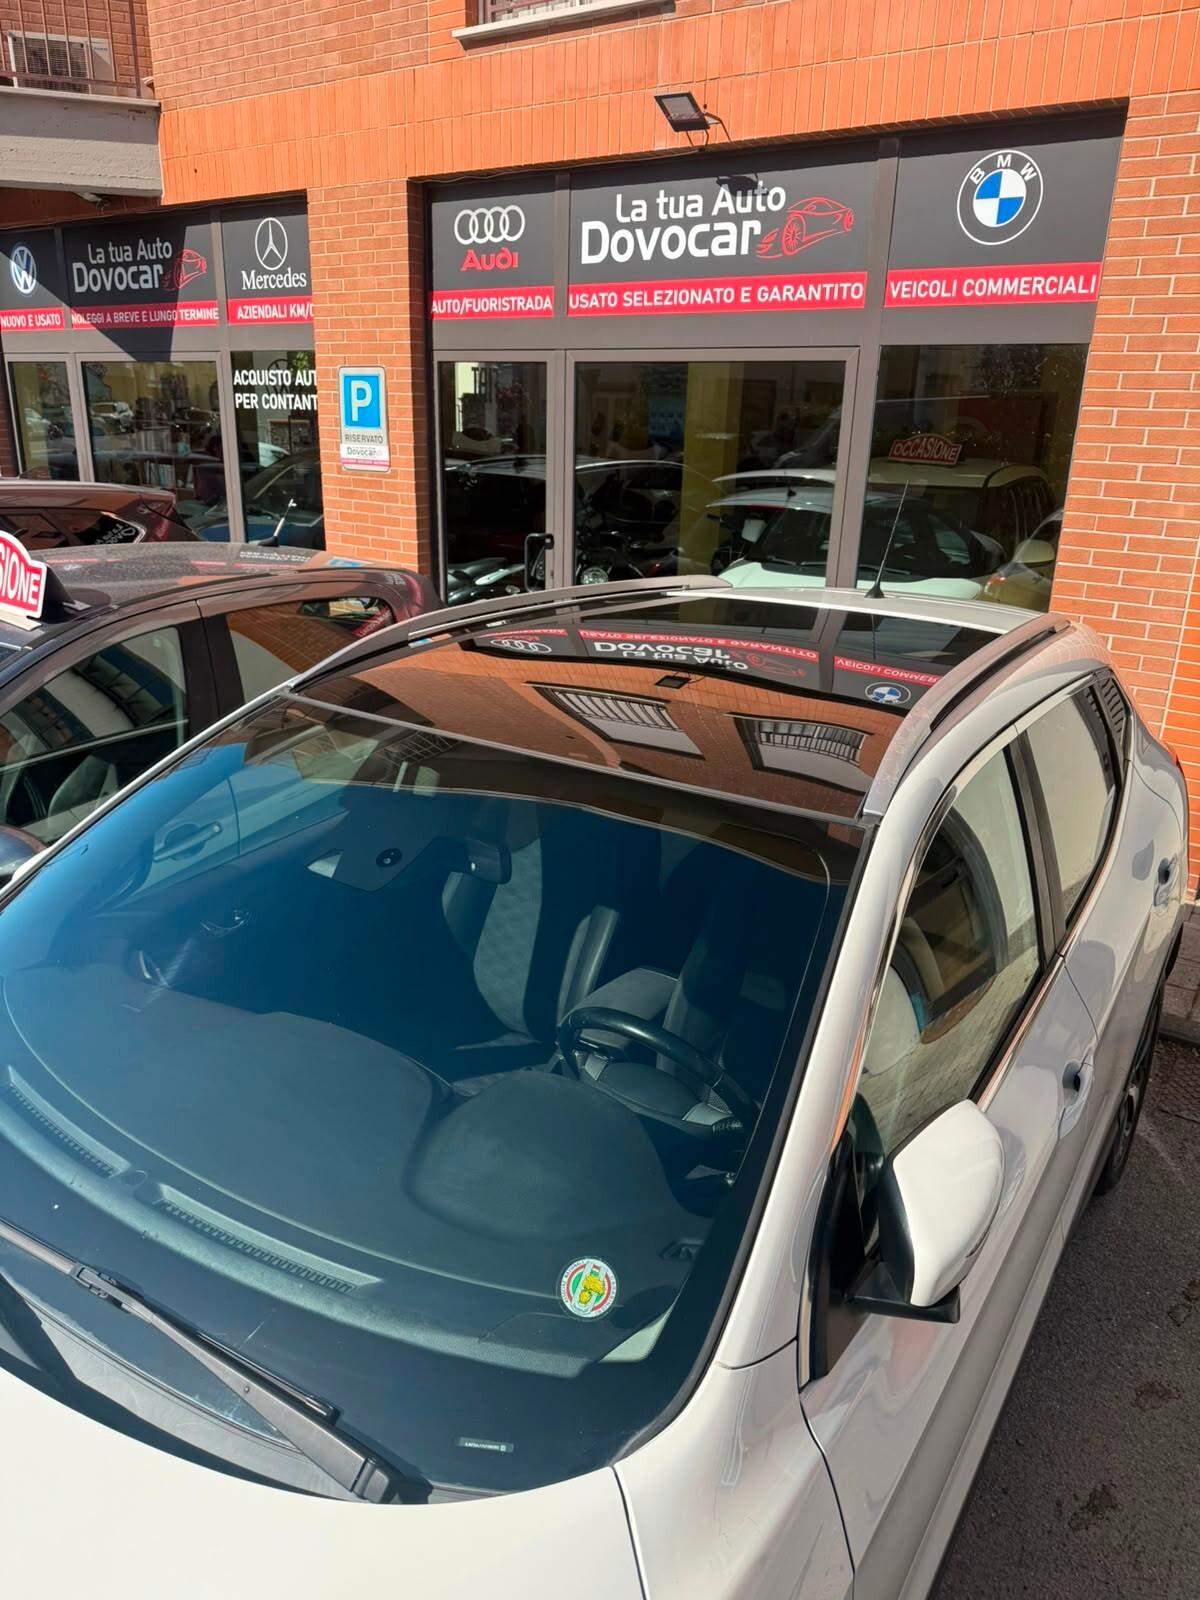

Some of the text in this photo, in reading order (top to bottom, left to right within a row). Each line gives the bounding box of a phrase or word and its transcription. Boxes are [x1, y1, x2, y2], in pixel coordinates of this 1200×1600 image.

[969, 154, 1037, 185] BMW
[616, 180, 786, 223] La tua Auto
[87, 237, 173, 265] La tua Auto
[581, 219, 761, 264] Dovocar
[460, 247, 519, 271] Audi
[72, 262, 163, 293] Dovocar
[241, 267, 307, 290] Mercedes
[890, 274, 1097, 299] VEICOLI COMMERCIALI
[430, 295, 553, 315] AUTO/FUORISTRADA
[569, 282, 864, 309] USATO SELEZIONATO E GARANTITO
[0, 312, 61, 328] NUOVO E USATO
[71, 307, 219, 325] NOLEGGI A BREVE E LUNGO TERMINE
[237, 304, 288, 320] AZIENDALI
[233, 369, 292, 386] ACQUISTO
[235, 393, 259, 409] PER
[350, 380, 372, 421] P
[344, 433, 384, 444] RISERVATO
[893, 438, 957, 460] OCCASIONE
